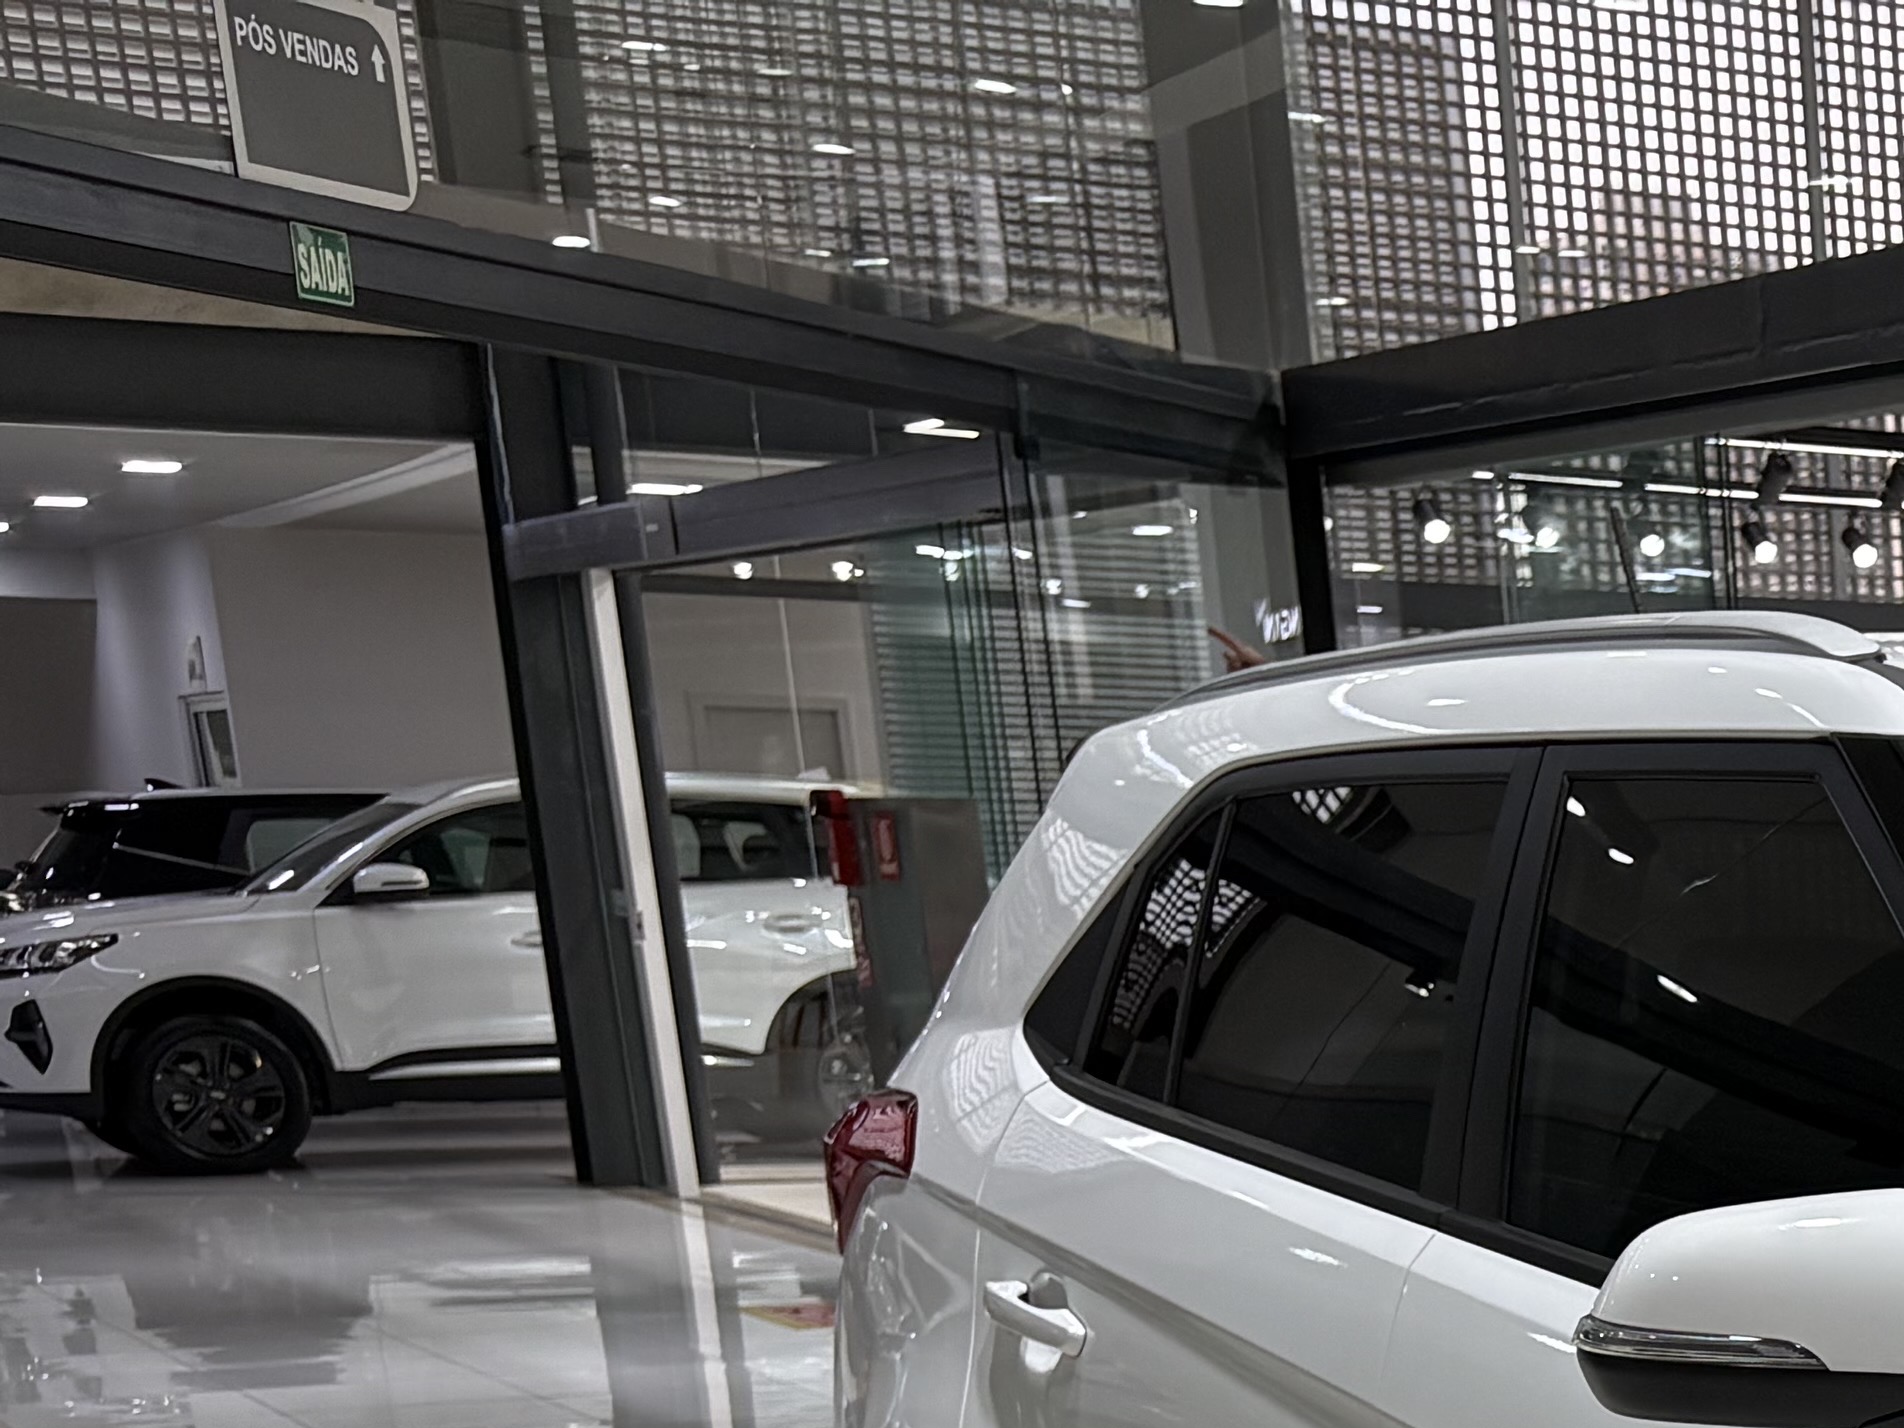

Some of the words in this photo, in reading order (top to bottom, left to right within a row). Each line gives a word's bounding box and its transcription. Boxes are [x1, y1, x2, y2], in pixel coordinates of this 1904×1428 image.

[233, 14, 277, 56] PÓS
[278, 27, 360, 76] VENDAS
[298, 236, 350, 296] SAÍDA
